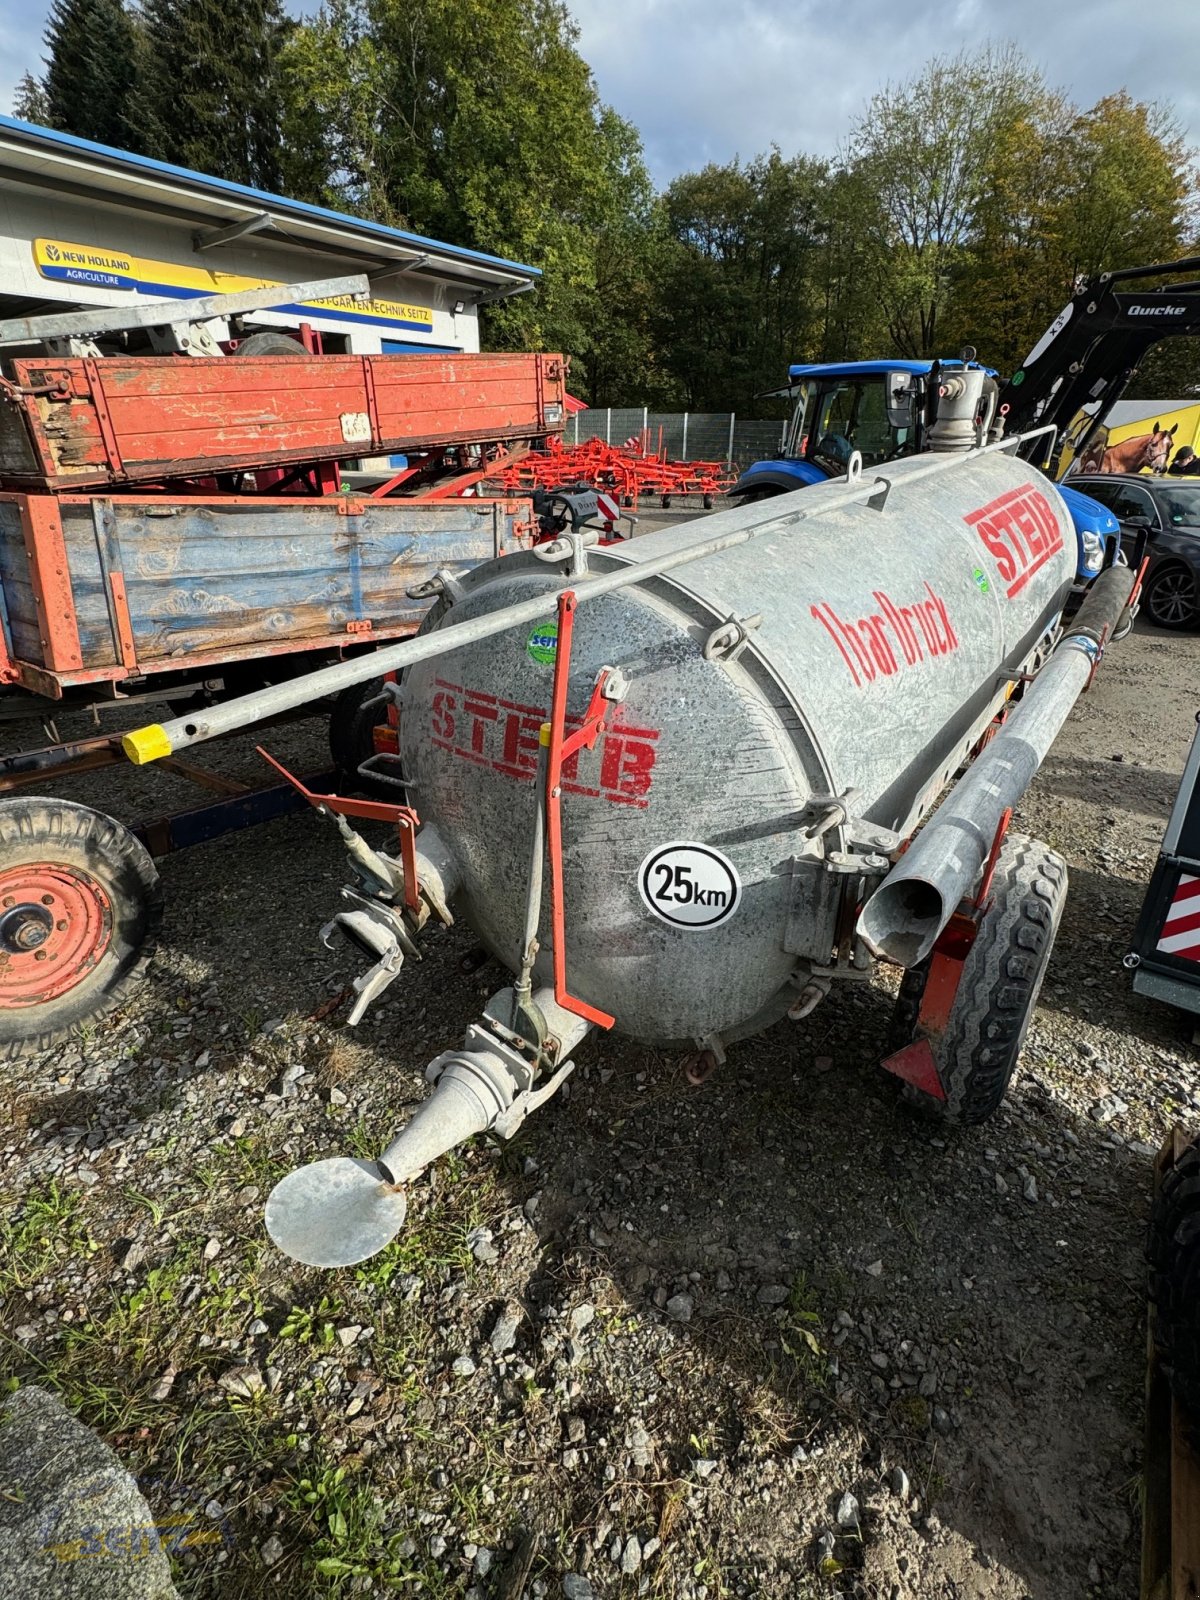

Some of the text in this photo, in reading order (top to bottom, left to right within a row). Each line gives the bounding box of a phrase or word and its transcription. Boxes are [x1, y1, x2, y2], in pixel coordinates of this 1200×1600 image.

[62, 251, 130, 271] NEW HOLLAND
[66, 269, 119, 285] AGRICULTURE
[407, 308, 429, 320] SEITZ
[1127, 305, 1186, 316] Quicke
[977, 490, 1061, 582] STEIB
